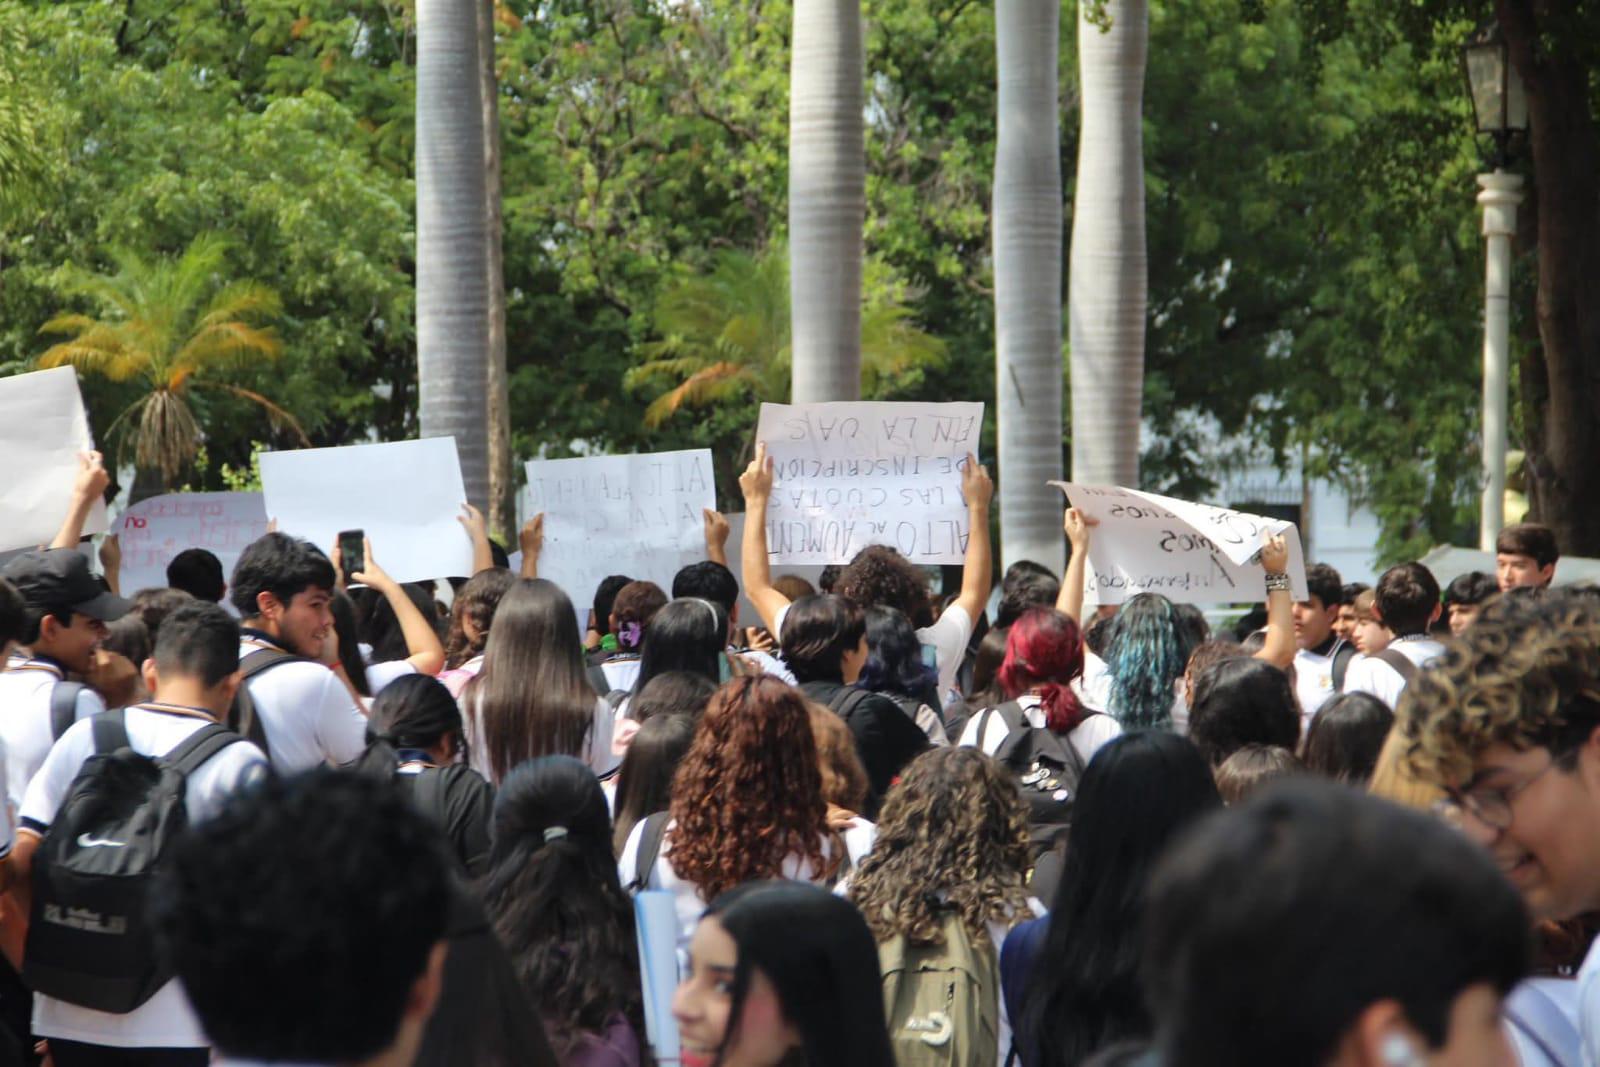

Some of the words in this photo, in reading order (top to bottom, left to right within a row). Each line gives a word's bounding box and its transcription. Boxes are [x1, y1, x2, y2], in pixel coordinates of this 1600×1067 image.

[784, 416, 859, 441] UAS
[882, 416, 916, 441] LA
[940, 456, 969, 473] DE
[768, 487, 887, 509] CUOTAS
[899, 486, 944, 506] LAS
[767, 519, 856, 558] AUMENT
[868, 520, 887, 534] AL
[896, 520, 970, 557] ALTO
